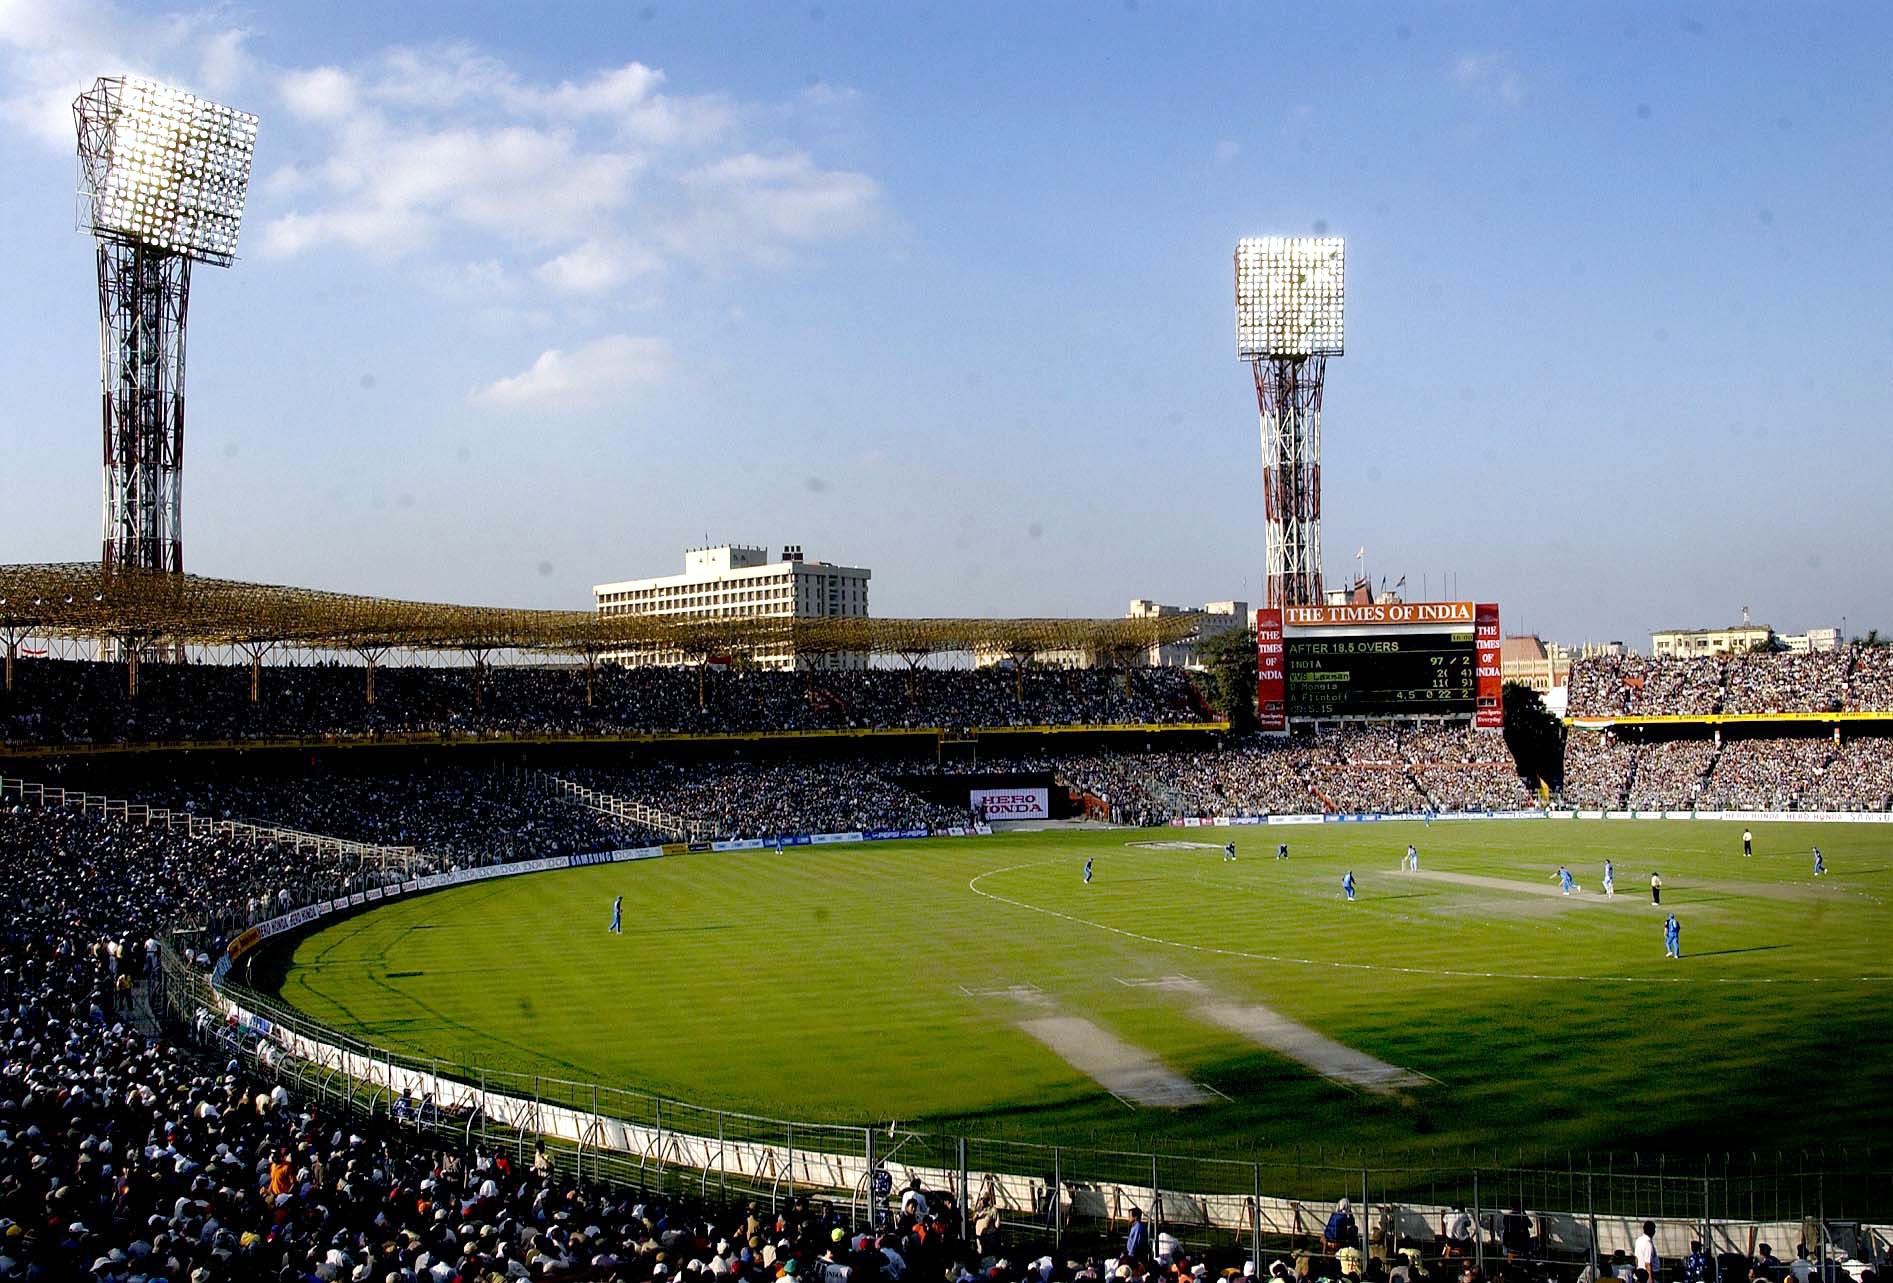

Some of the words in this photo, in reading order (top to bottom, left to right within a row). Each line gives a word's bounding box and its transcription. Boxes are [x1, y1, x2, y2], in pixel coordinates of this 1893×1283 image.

[1286, 607, 1324, 622] THE
[1328, 606, 1385, 621] TIMES
[1389, 605, 1414, 620] OF
[1418, 604, 1470, 619] INDIA
[1478, 626, 1497, 635] THE
[1260, 631, 1280, 640] THE
[1258, 644, 1283, 653] TIMES
[1290, 643, 1328, 654] AFTER
[1333, 642, 1355, 653] 18.5
[1358, 642, 1399, 652] OVERS
[1475, 640, 1500, 649] TIMES
[1266, 658, 1277, 666] OF
[1482, 653, 1494, 662] OF
[1291, 660, 1321, 669] INDIA
[1430, 657, 1443, 665] 97
[1463, 656, 1470, 665] 2
[1258, 671, 1283, 680] INDIA
[1475, 667, 1500, 677] INDIA
[982, 795, 1036, 804] HERO
[570, 851, 611, 866] SAMSUNG
